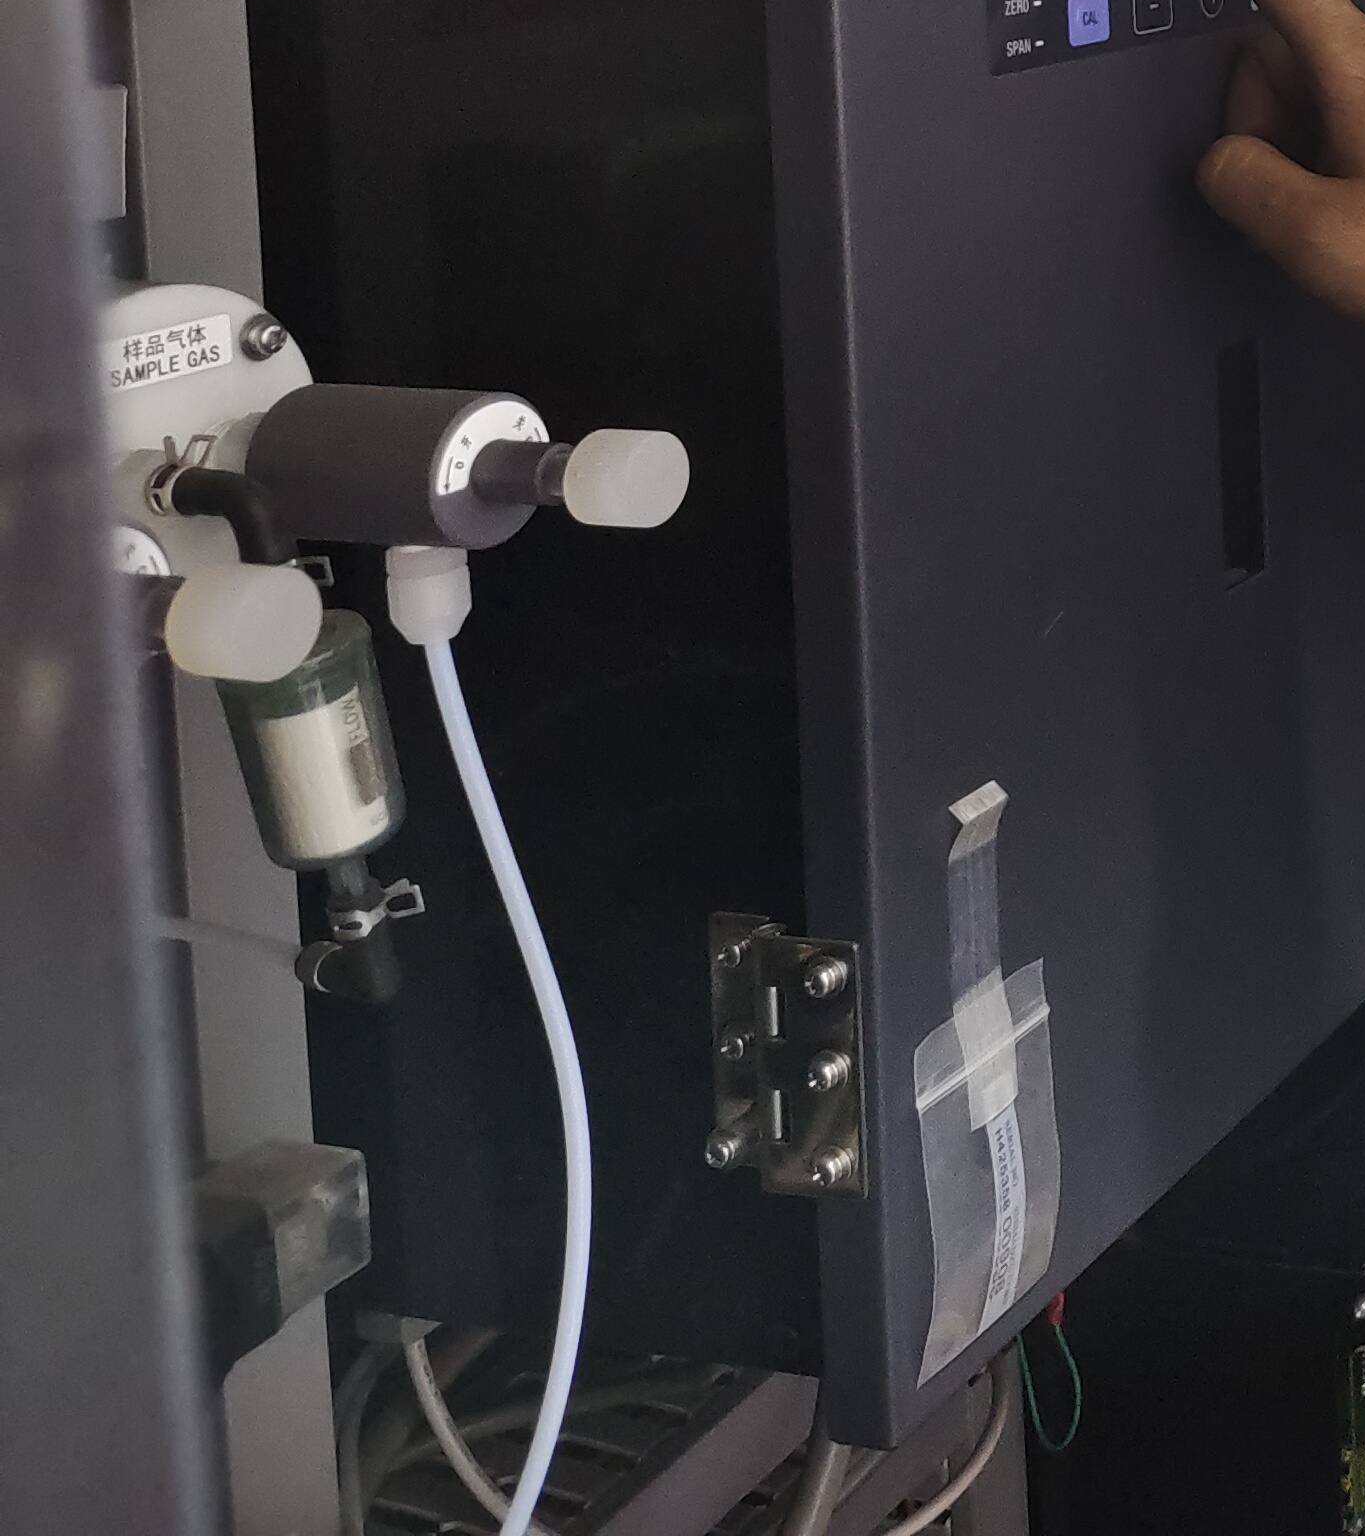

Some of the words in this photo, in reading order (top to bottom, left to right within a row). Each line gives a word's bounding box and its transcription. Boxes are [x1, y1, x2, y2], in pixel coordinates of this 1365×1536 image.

[1082, 10, 1099, 26] CAL
[1006, 38, 1032, 58] SPAN
[122, 323, 208, 363] 样品气体
[111, 354, 181, 388] SAMPLE
[187, 344, 221, 368] GAS
